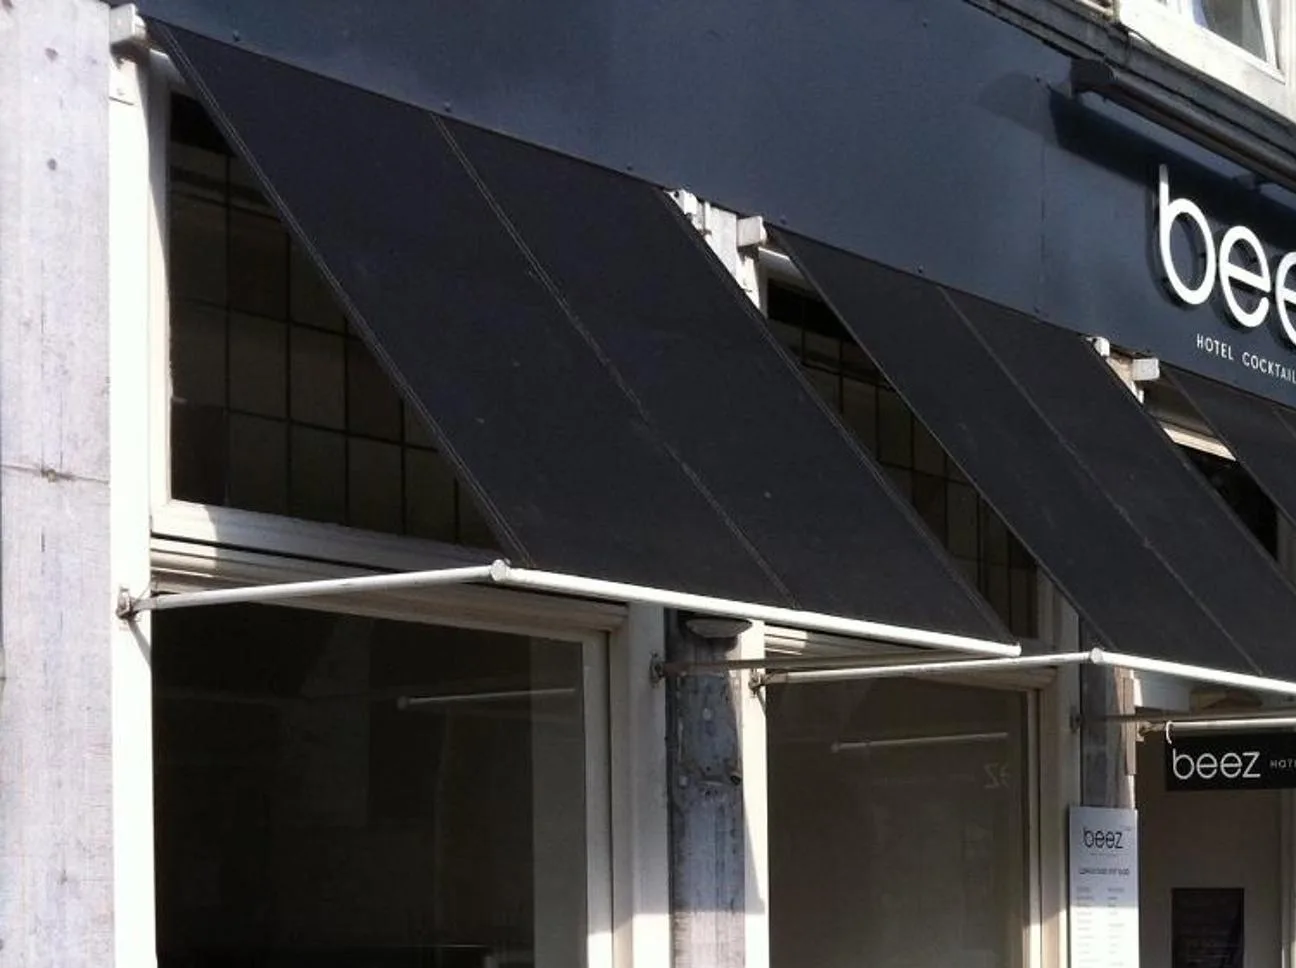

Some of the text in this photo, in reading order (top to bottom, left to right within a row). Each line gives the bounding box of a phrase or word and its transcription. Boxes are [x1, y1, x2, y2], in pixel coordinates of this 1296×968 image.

[1196, 333, 1234, 361] HOTEL
[1172, 748, 1261, 780] beez
[1082, 826, 1123, 849] beez
